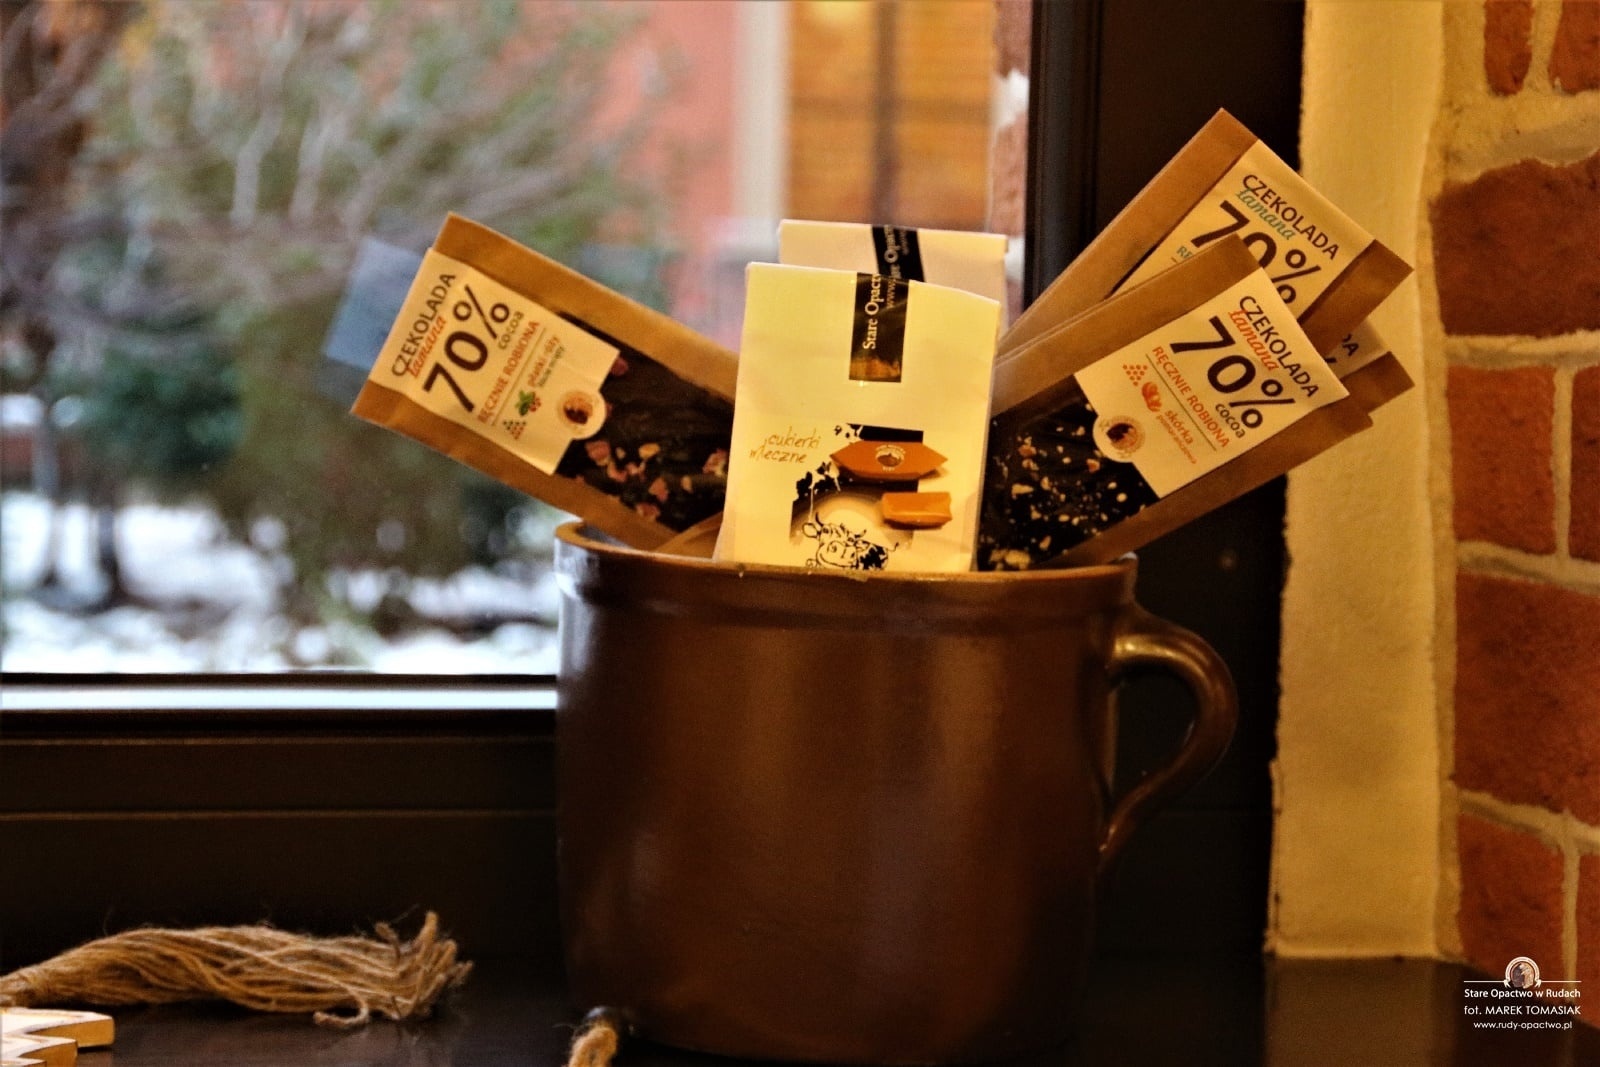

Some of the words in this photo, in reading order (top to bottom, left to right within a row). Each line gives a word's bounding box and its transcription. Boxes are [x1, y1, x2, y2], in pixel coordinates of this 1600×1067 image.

[1191, 200, 1321, 304] 70%
[1242, 174, 1339, 260] CZEKOLADA
[391, 273, 456, 377] CZEKOLADA
[422, 284, 510, 413] 70%
[498, 311, 524, 350] cocoa
[503, 321, 539, 376] ROBIONA
[862, 318, 878, 350] Stare
[1239, 296, 1319, 397] CZEKOLADA
[1152, 346, 1191, 395] RĘCZNIE
[1187, 395, 1230, 447] ROBIONA
[1170, 315, 1296, 429] 70%
[768, 426, 821, 448] cukierki
[1165, 410, 1193, 444] skórka
[1215, 403, 1245, 438] cocoa
